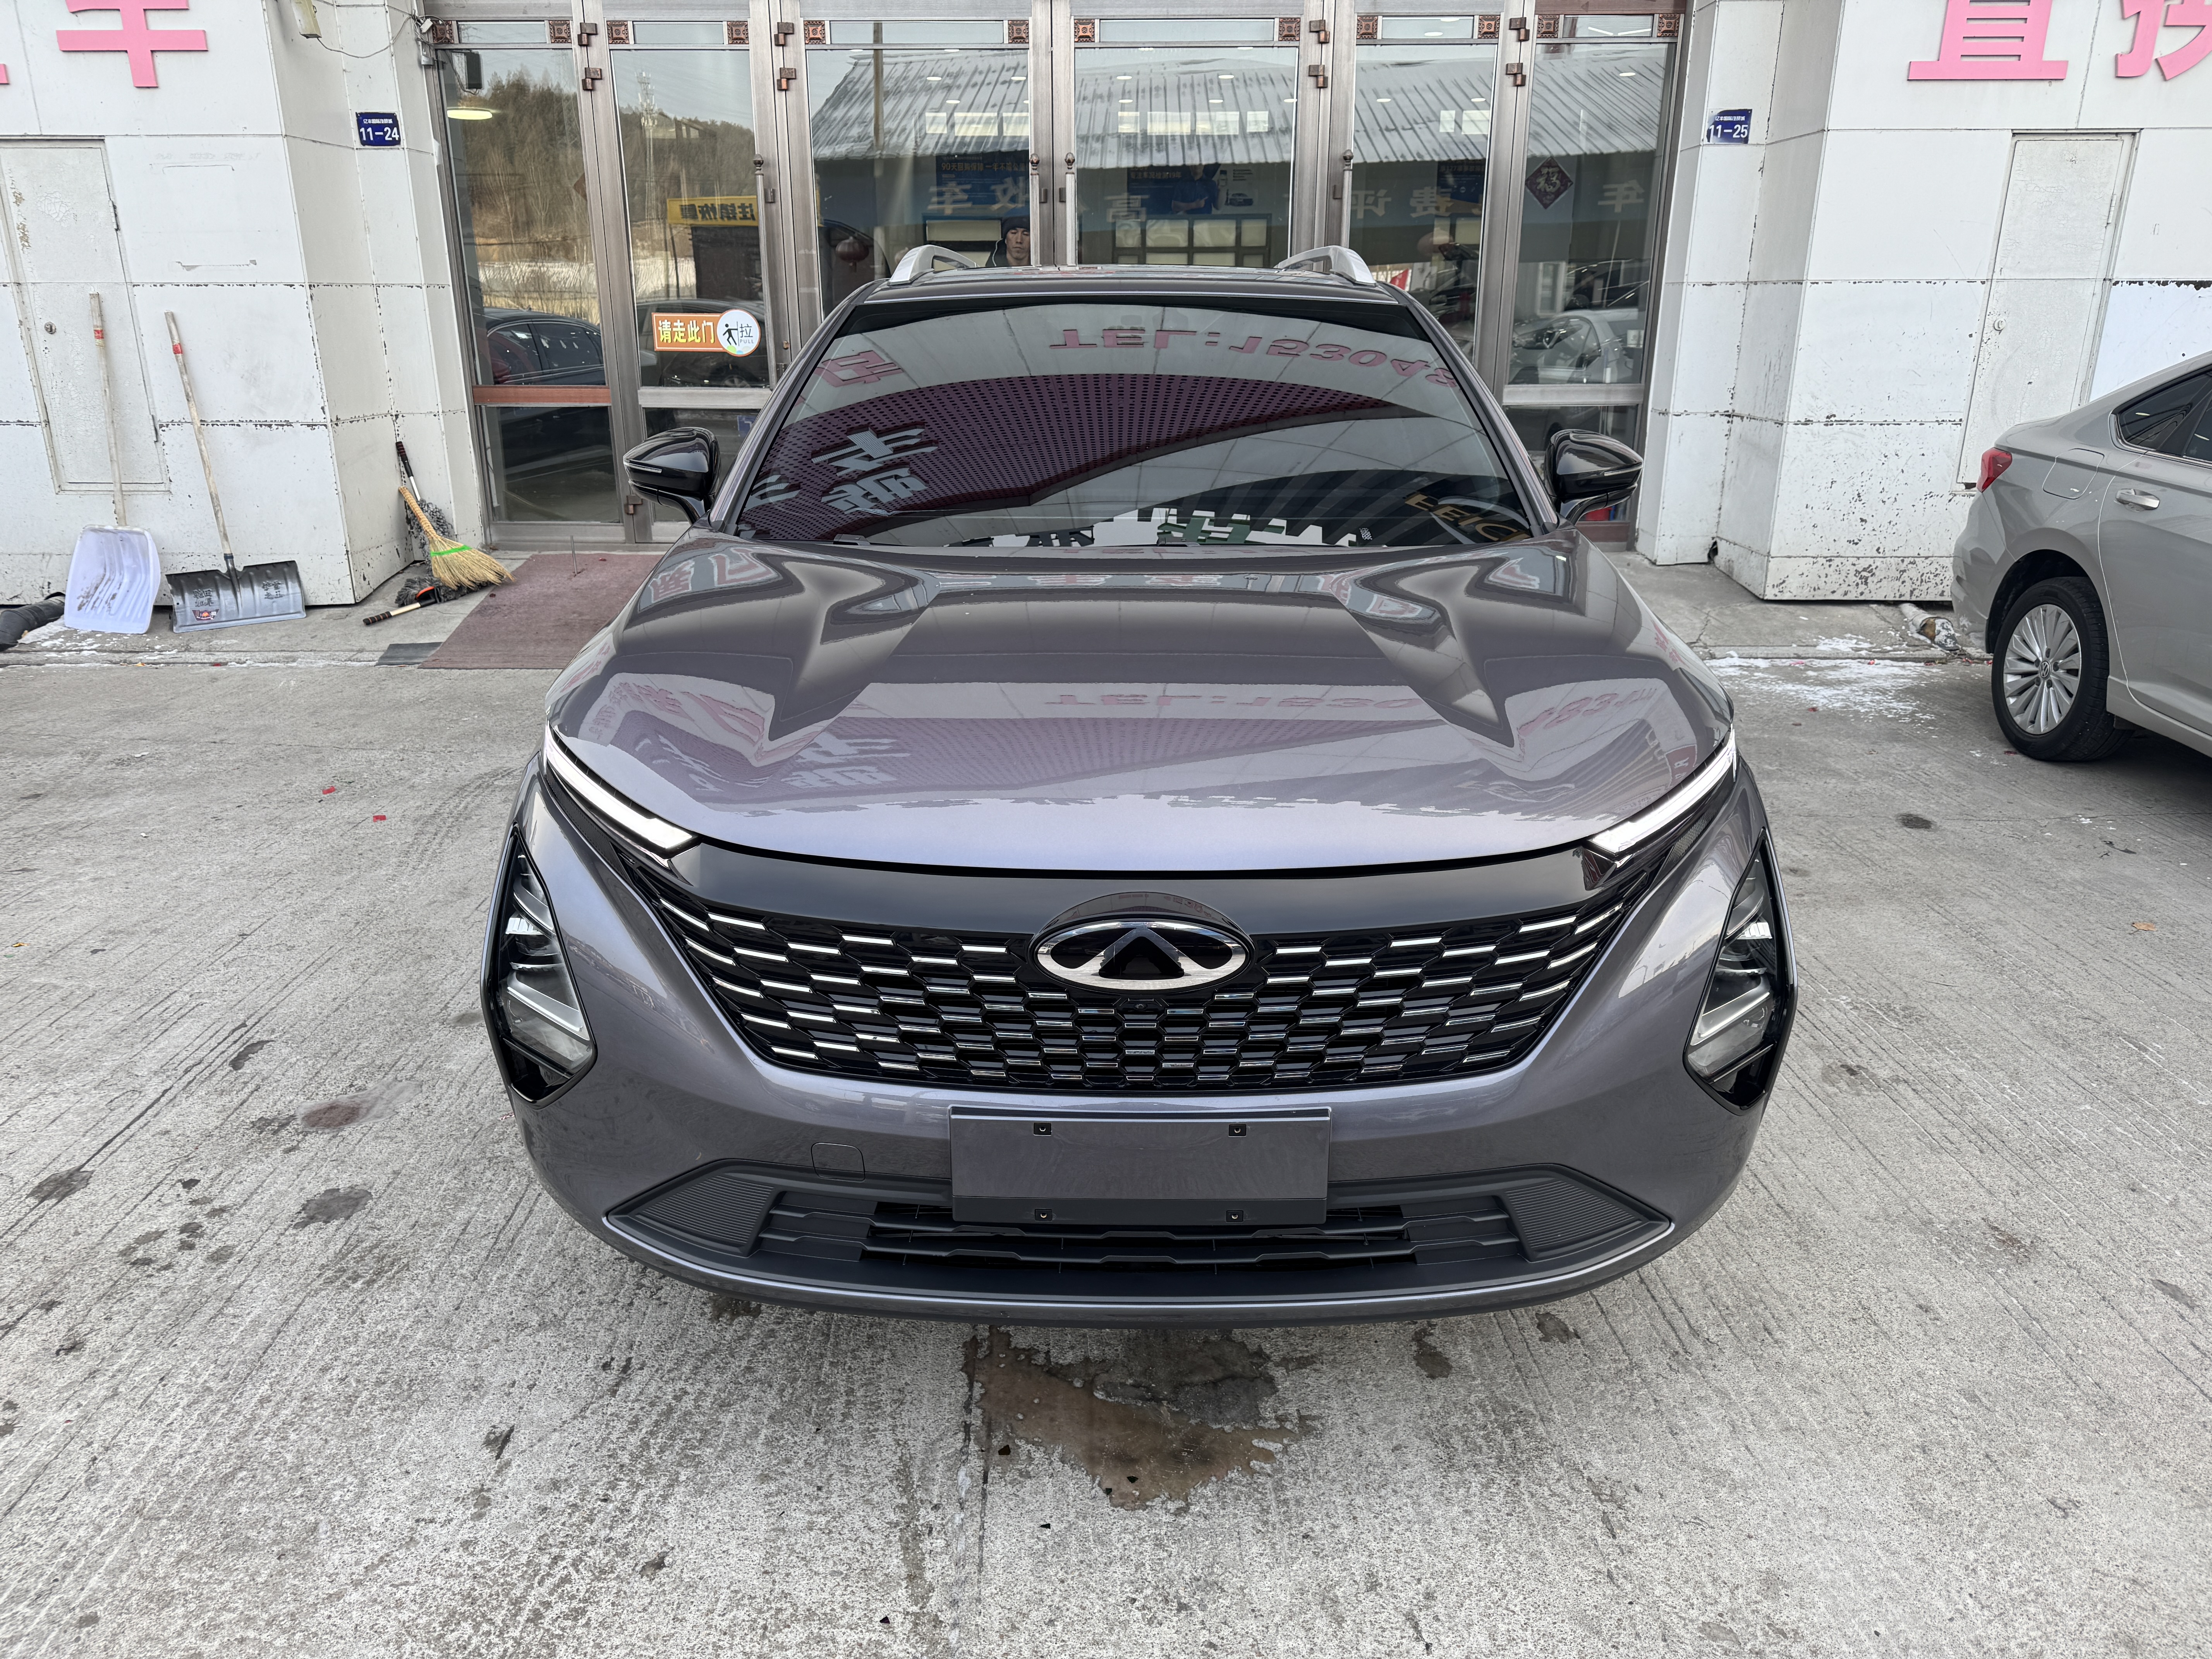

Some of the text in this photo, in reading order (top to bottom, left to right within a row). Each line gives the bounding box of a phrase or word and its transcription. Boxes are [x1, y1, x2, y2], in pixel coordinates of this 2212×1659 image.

[360, 127, 399, 141] 11-24
[1709, 124, 1748, 138] 11-25
[658, 319, 715, 343] 请走此门
[739, 323, 753, 338] 拉
